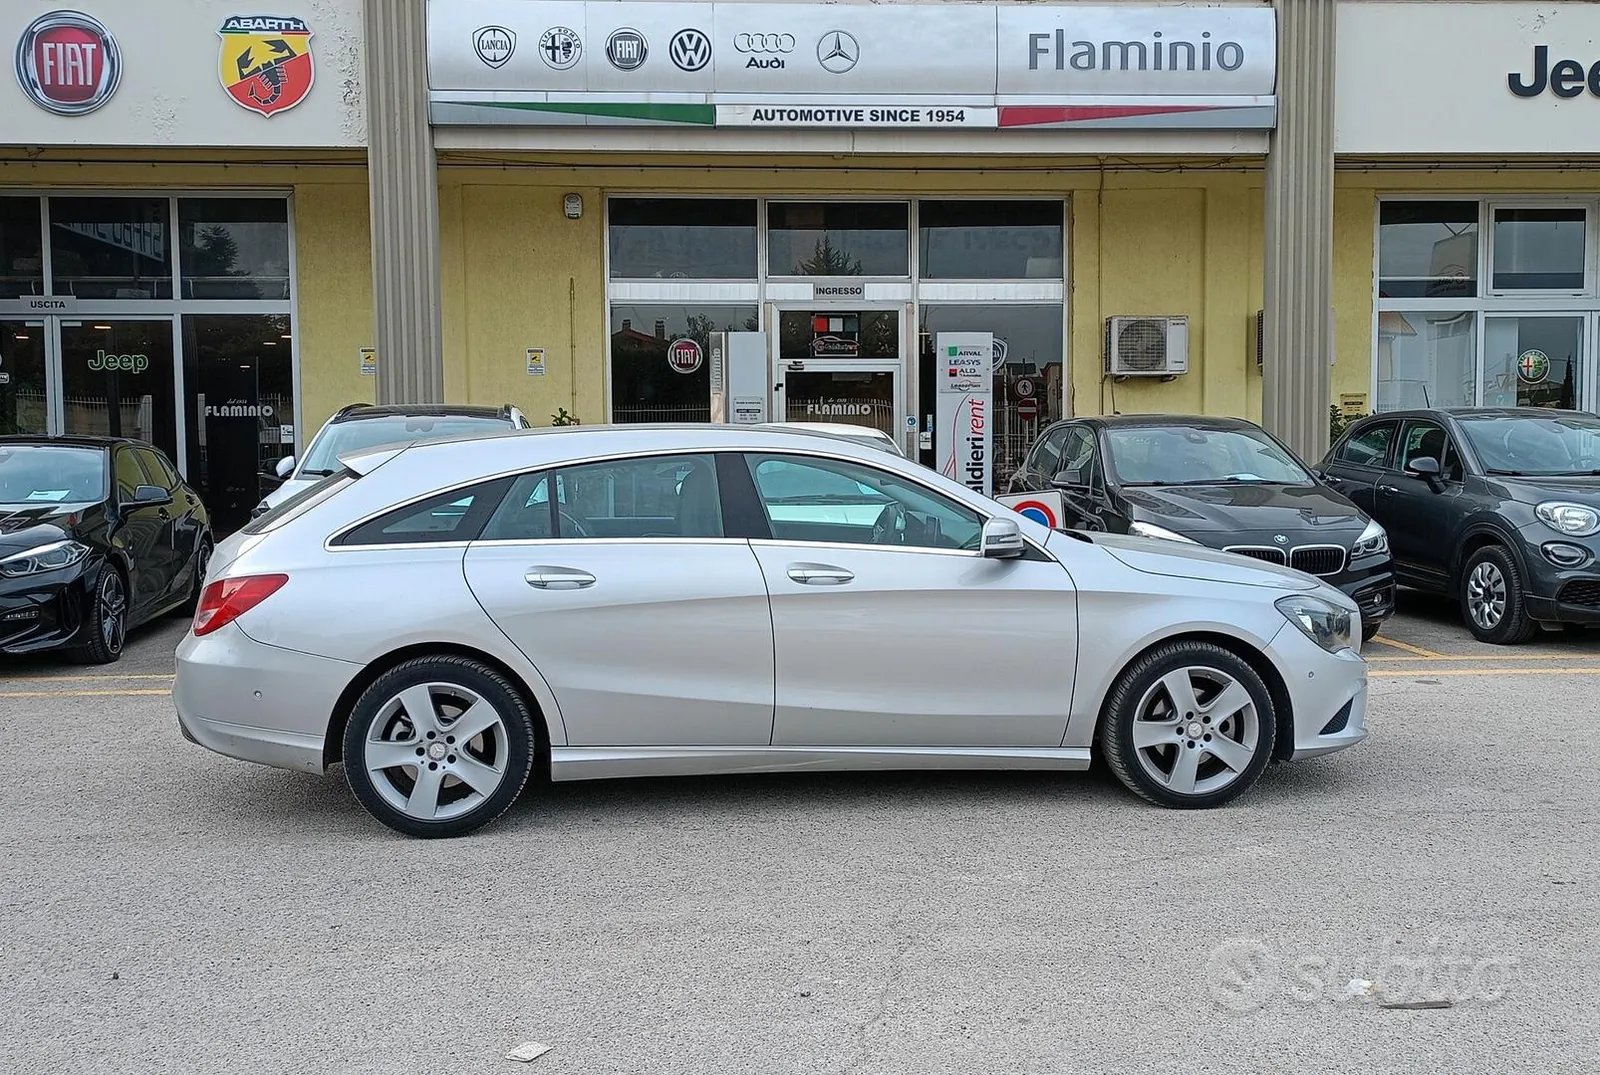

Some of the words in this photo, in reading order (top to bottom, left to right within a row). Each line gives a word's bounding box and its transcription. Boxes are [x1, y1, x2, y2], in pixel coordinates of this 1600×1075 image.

[226, 18, 304, 30] ABARTH
[481, 39, 508, 51] LANCIA
[540, 31, 553, 49] ALFA
[557, 28, 581, 49] ROMEO
[616, 40, 639, 59] FIAT
[1028, 28, 1244, 72] Flaminio
[42, 41, 97, 87] FIAT
[745, 56, 785, 69] Audi
[752, 108, 864, 122] AUTOMOTIVE
[869, 109, 920, 122] SINCE
[926, 109, 965, 123] 1954
[815, 286, 863, 296] INGRESSO
[30, 300, 66, 309] USCITA
[87, 349, 149, 374] Jeep
[676, 348, 695, 364] FIAT
[205, 405, 274, 417] FLAMINIO
[807, 403, 872, 415] FLAMINIO
